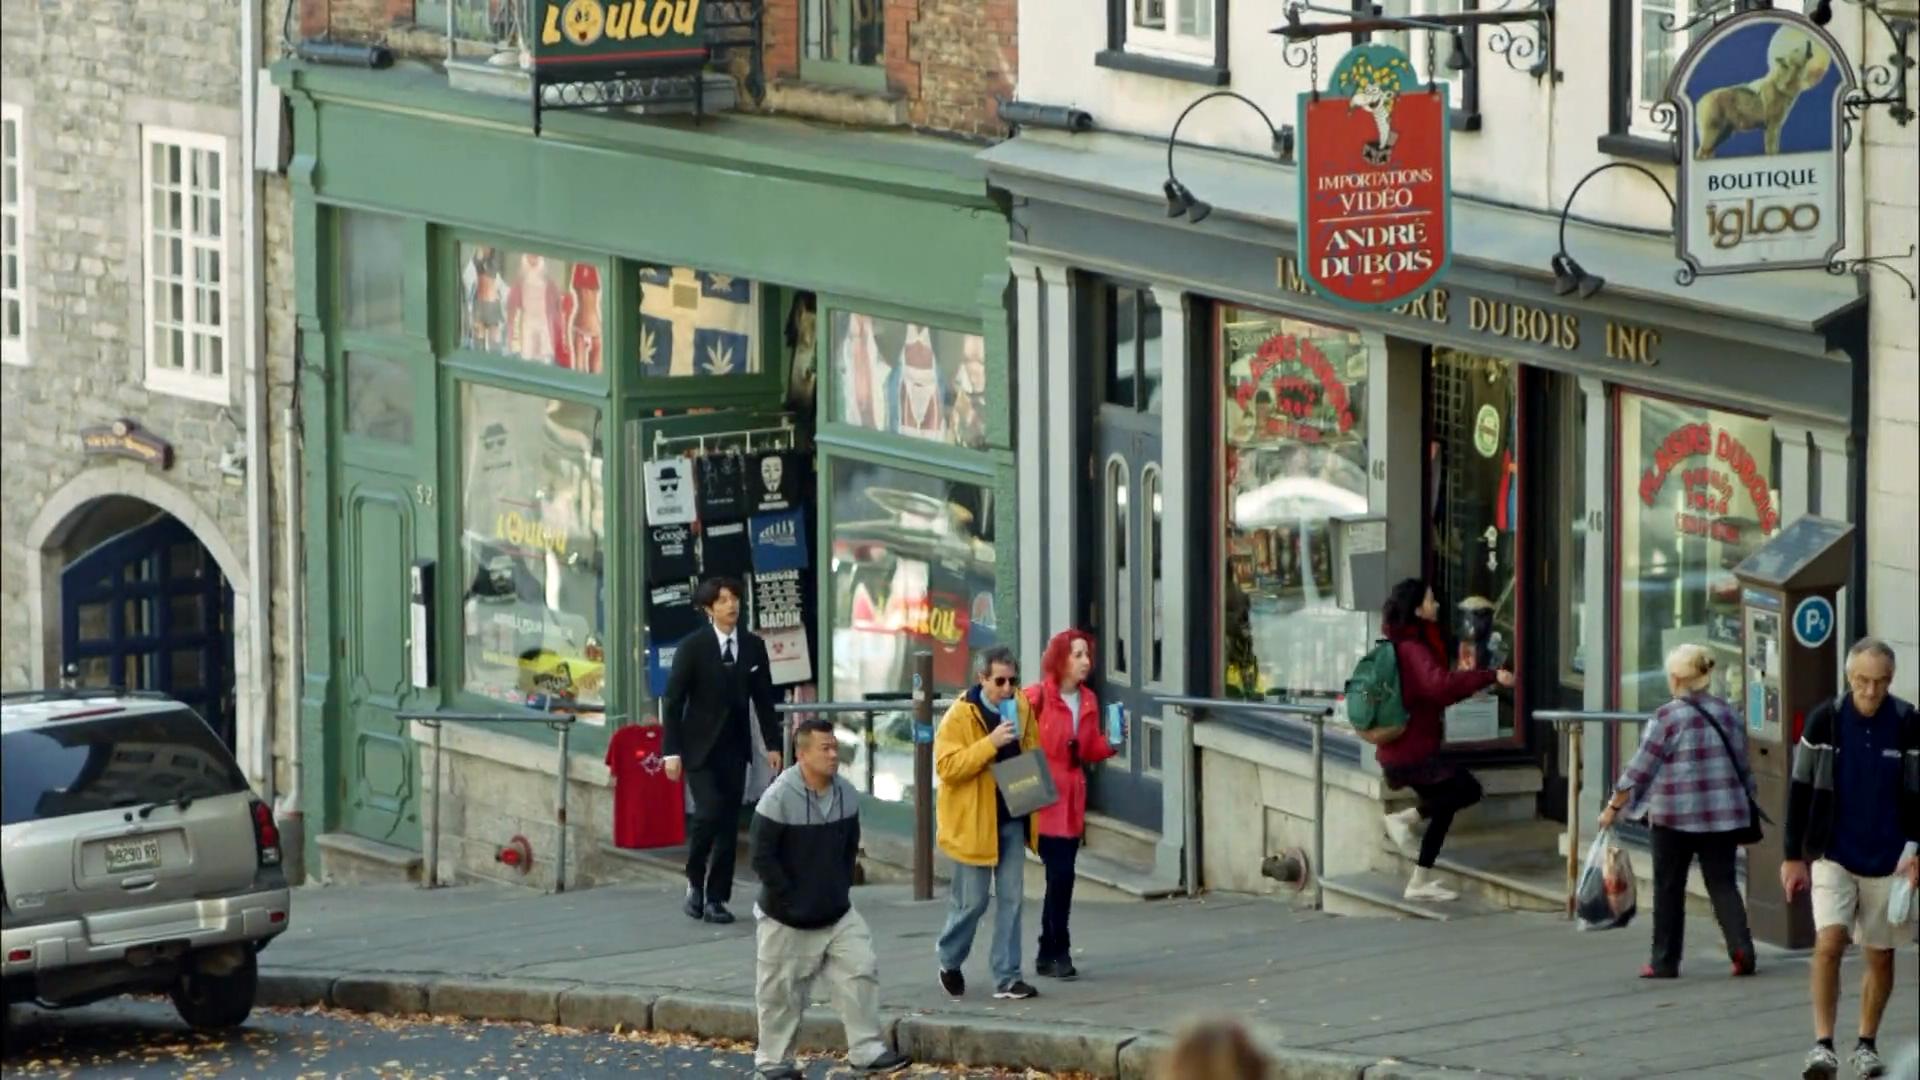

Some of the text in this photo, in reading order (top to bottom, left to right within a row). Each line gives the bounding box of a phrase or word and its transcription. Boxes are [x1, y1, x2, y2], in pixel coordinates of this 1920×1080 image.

[541, 0, 700, 46] LOULOU
[1318, 168, 1433, 190] IMPORTATIONS
[1708, 168, 1818, 191] BOUTIQUE
[1340, 187, 1413, 215] VIDÉO
[1326, 218, 1428, 250] ANDRÉ
[1706, 198, 1820, 249] igloo
[1321, 250, 1433, 278] DUBOIS
[1469, 296, 1579, 350] DUBOIS
[1606, 322, 1660, 366] INC
[759, 611, 801, 628] BACON
